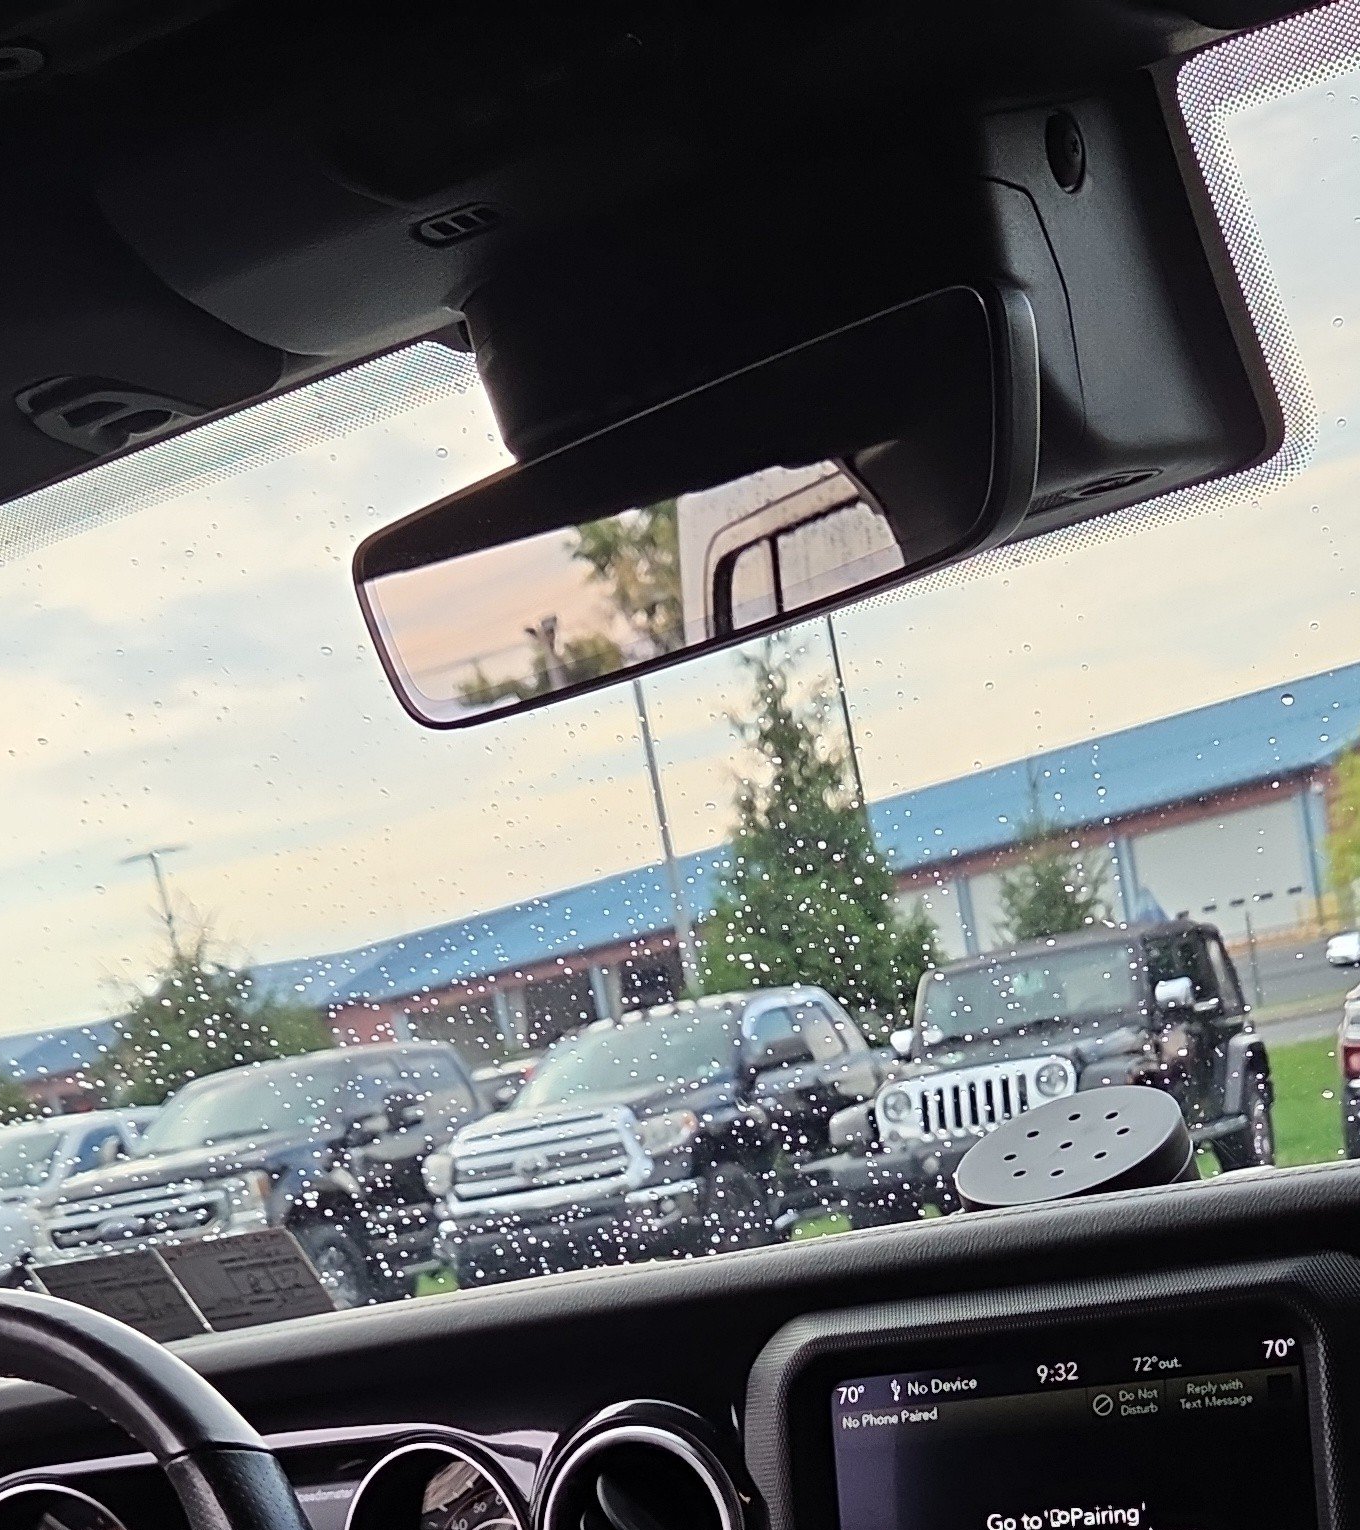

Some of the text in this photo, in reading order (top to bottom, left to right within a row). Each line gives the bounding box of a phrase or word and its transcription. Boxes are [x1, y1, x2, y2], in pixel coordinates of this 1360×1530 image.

[1036, 1361, 1079, 1384] 9:32
[907, 1376, 978, 1396] No Device
[1186, 1378, 1244, 1396] Reply with
[1118, 1388, 1158, 1402] Do Not
[1179, 1394, 1253, 1410] Text Message
[1120, 1402, 1158, 1416] Disturb
[842, 1406, 939, 1430] No Phone Paired
[1021, 1513, 1042, 1530] to
